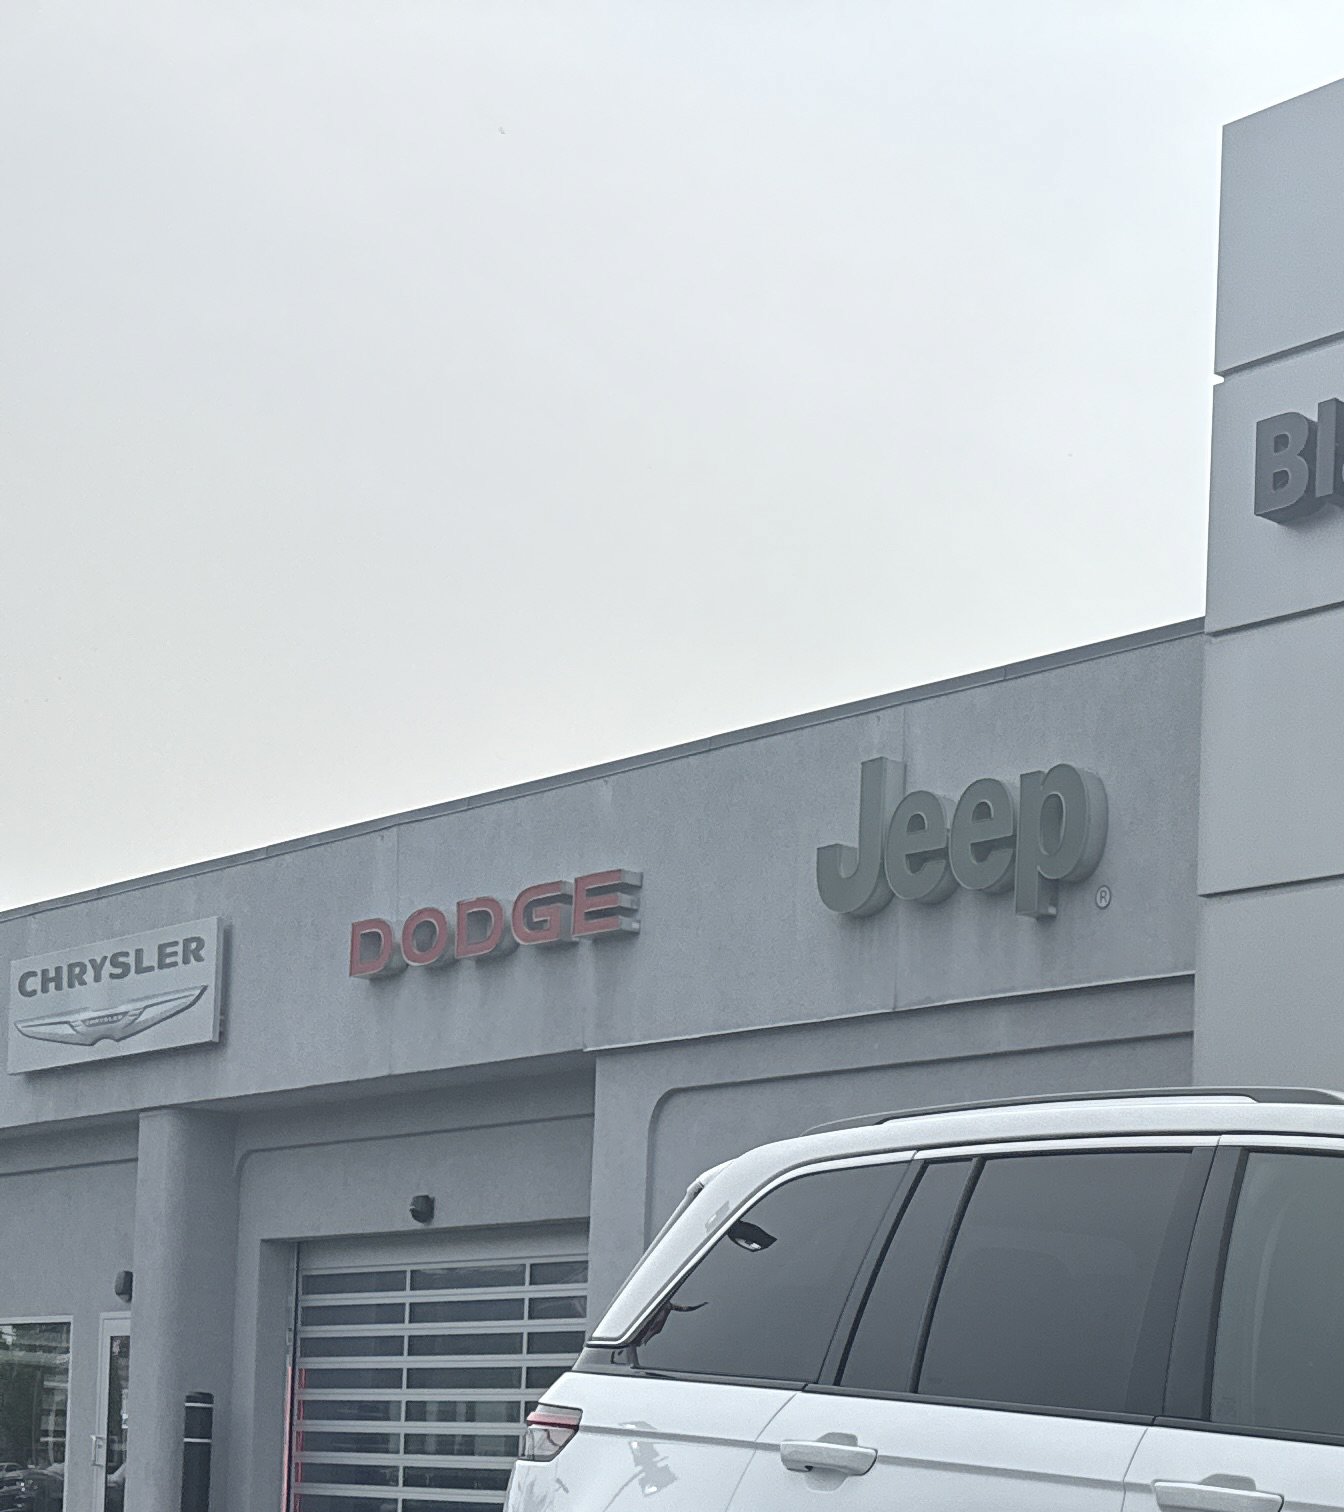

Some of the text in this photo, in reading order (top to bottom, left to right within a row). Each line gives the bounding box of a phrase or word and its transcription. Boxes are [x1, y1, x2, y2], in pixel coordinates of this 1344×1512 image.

[816, 756, 1108, 919] Jeep
[17, 935, 206, 998] CHRYSLER
[349, 868, 642, 978] DODGE
